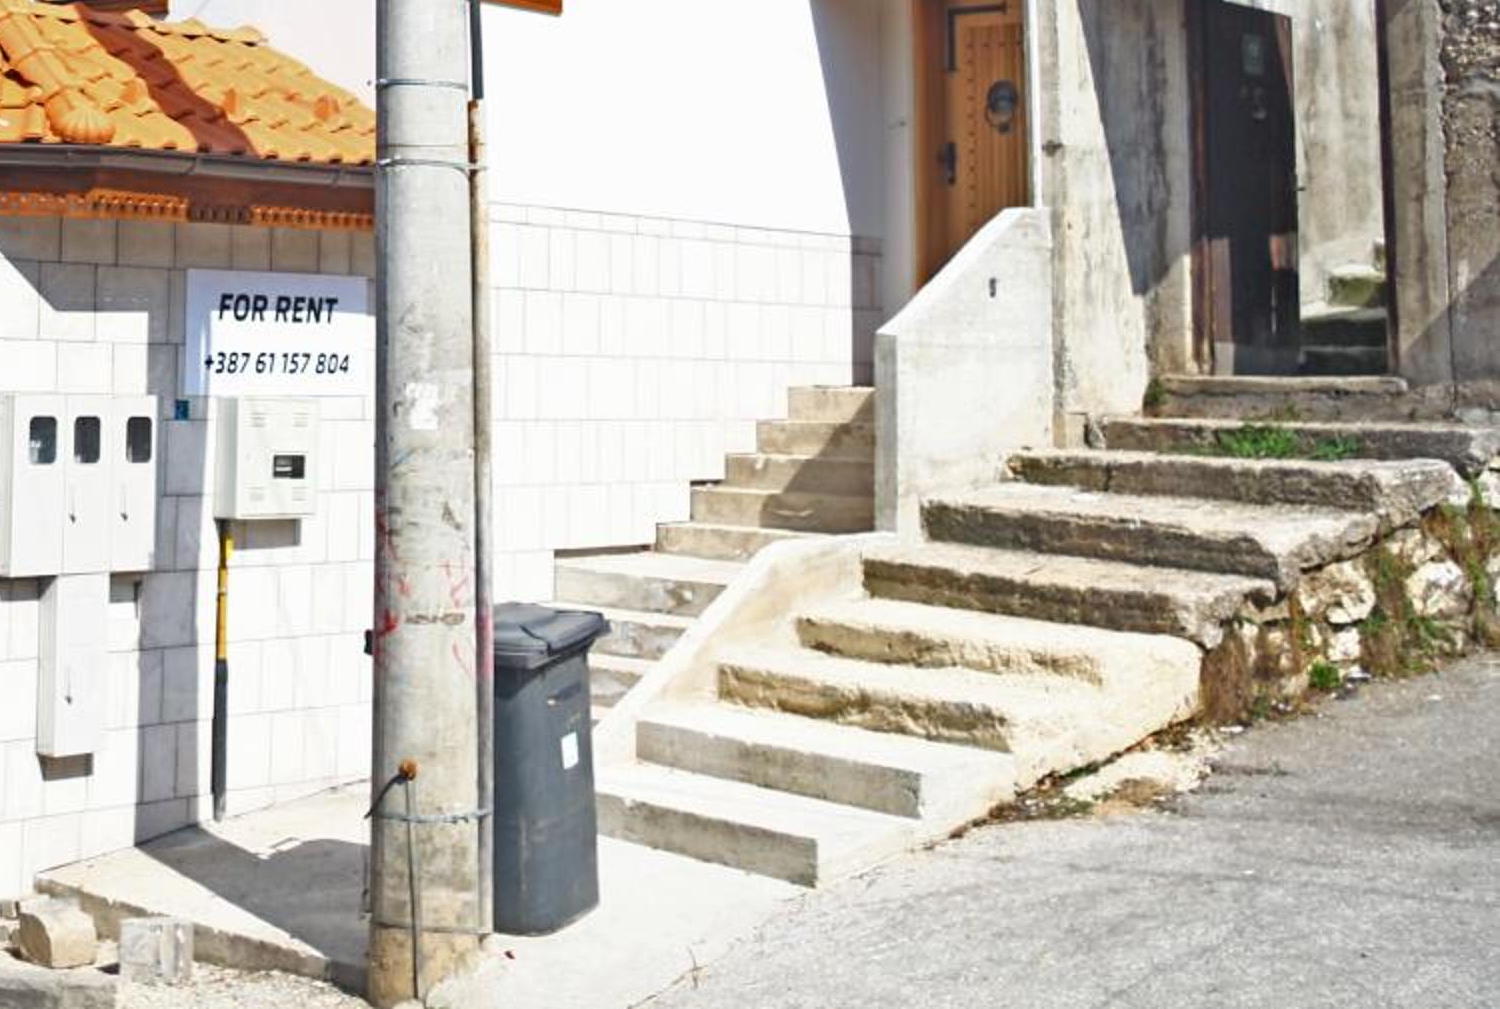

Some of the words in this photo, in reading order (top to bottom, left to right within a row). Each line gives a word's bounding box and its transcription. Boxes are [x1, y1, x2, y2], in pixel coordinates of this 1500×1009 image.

[218, 293, 268, 321] FOR
[274, 295, 339, 323] RENT
[204, 351, 251, 374] +387
[255, 352, 275, 373] 61
[281, 352, 311, 374] 157
[315, 353, 349, 374] 804
